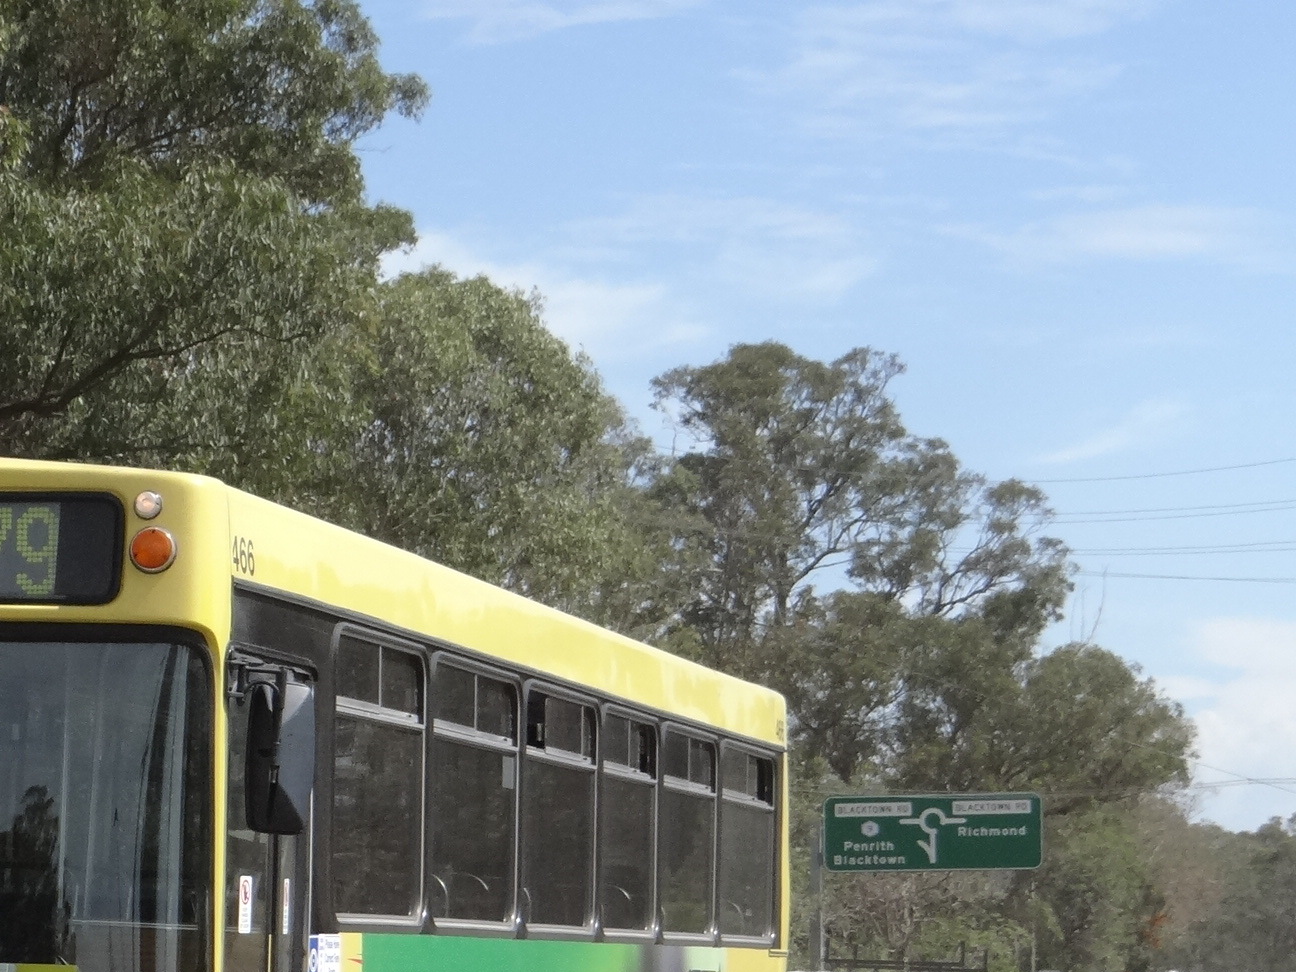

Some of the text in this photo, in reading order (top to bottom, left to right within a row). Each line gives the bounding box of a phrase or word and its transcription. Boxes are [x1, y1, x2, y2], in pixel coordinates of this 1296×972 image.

[232, 535, 255, 577] 466
[837, 805, 893, 815] BLACKTOWN
[957, 826, 1027, 837] Richmond
[843, 841, 895, 852] Penrith
[833, 855, 906, 865] Blacktown
